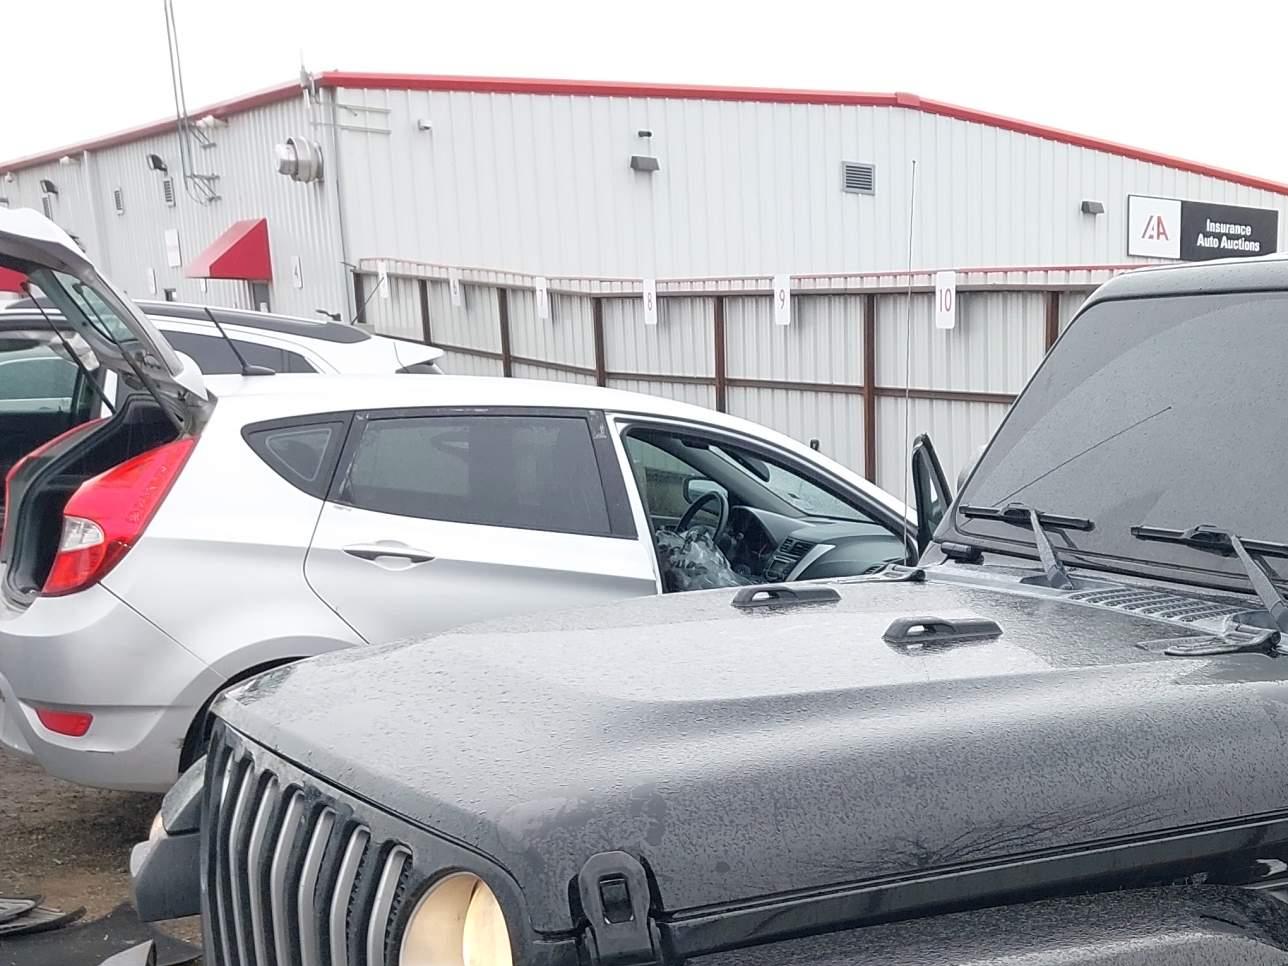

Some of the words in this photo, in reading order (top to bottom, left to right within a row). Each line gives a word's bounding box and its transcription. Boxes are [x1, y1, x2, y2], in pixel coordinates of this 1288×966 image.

[1206, 218, 1252, 236] Insurance
[1197, 233, 1219, 248] Auto
[1220, 235, 1260, 252] Auctions
[647, 291, 654, 311] 8
[779, 288, 786, 310] 9
[939, 288, 952, 312] 10
